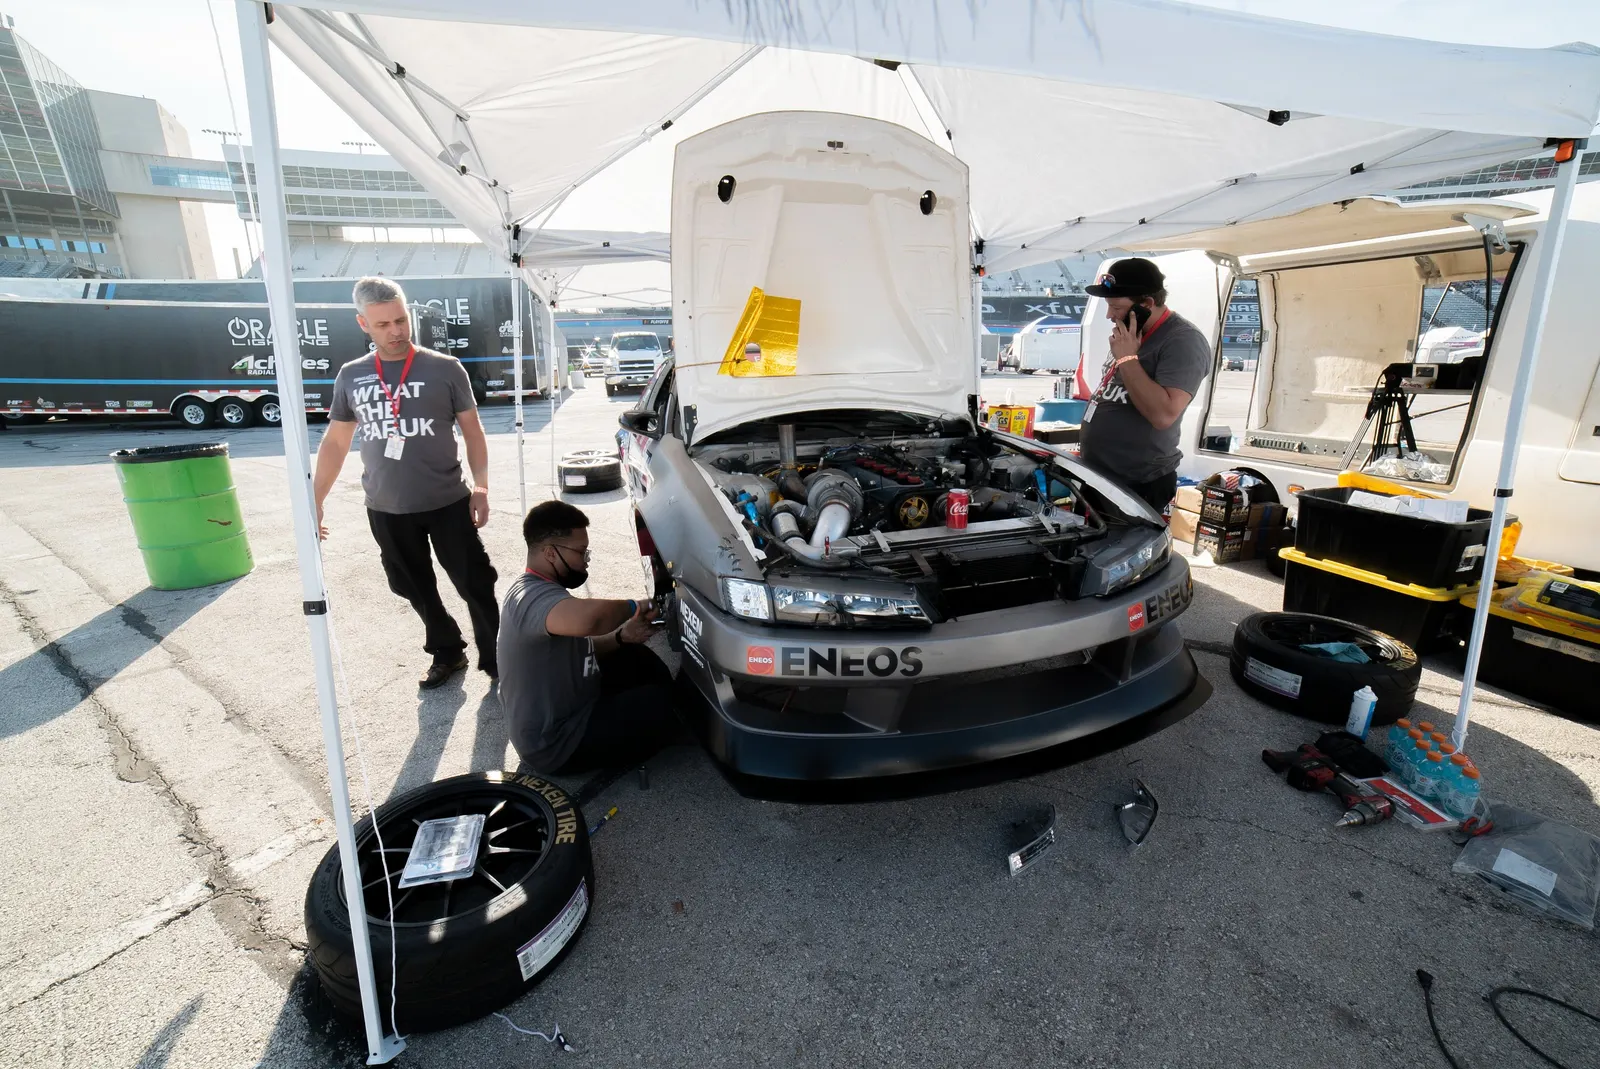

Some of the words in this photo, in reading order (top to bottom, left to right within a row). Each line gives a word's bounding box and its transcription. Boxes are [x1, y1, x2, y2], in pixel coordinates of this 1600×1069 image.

[353, 381, 425, 405] WHAT
[748, 656, 773, 664] ENEOS
[781, 646, 923, 677] ENEOS
[516, 775, 569, 809] NEXEN
[555, 807, 577, 845] TIRE
